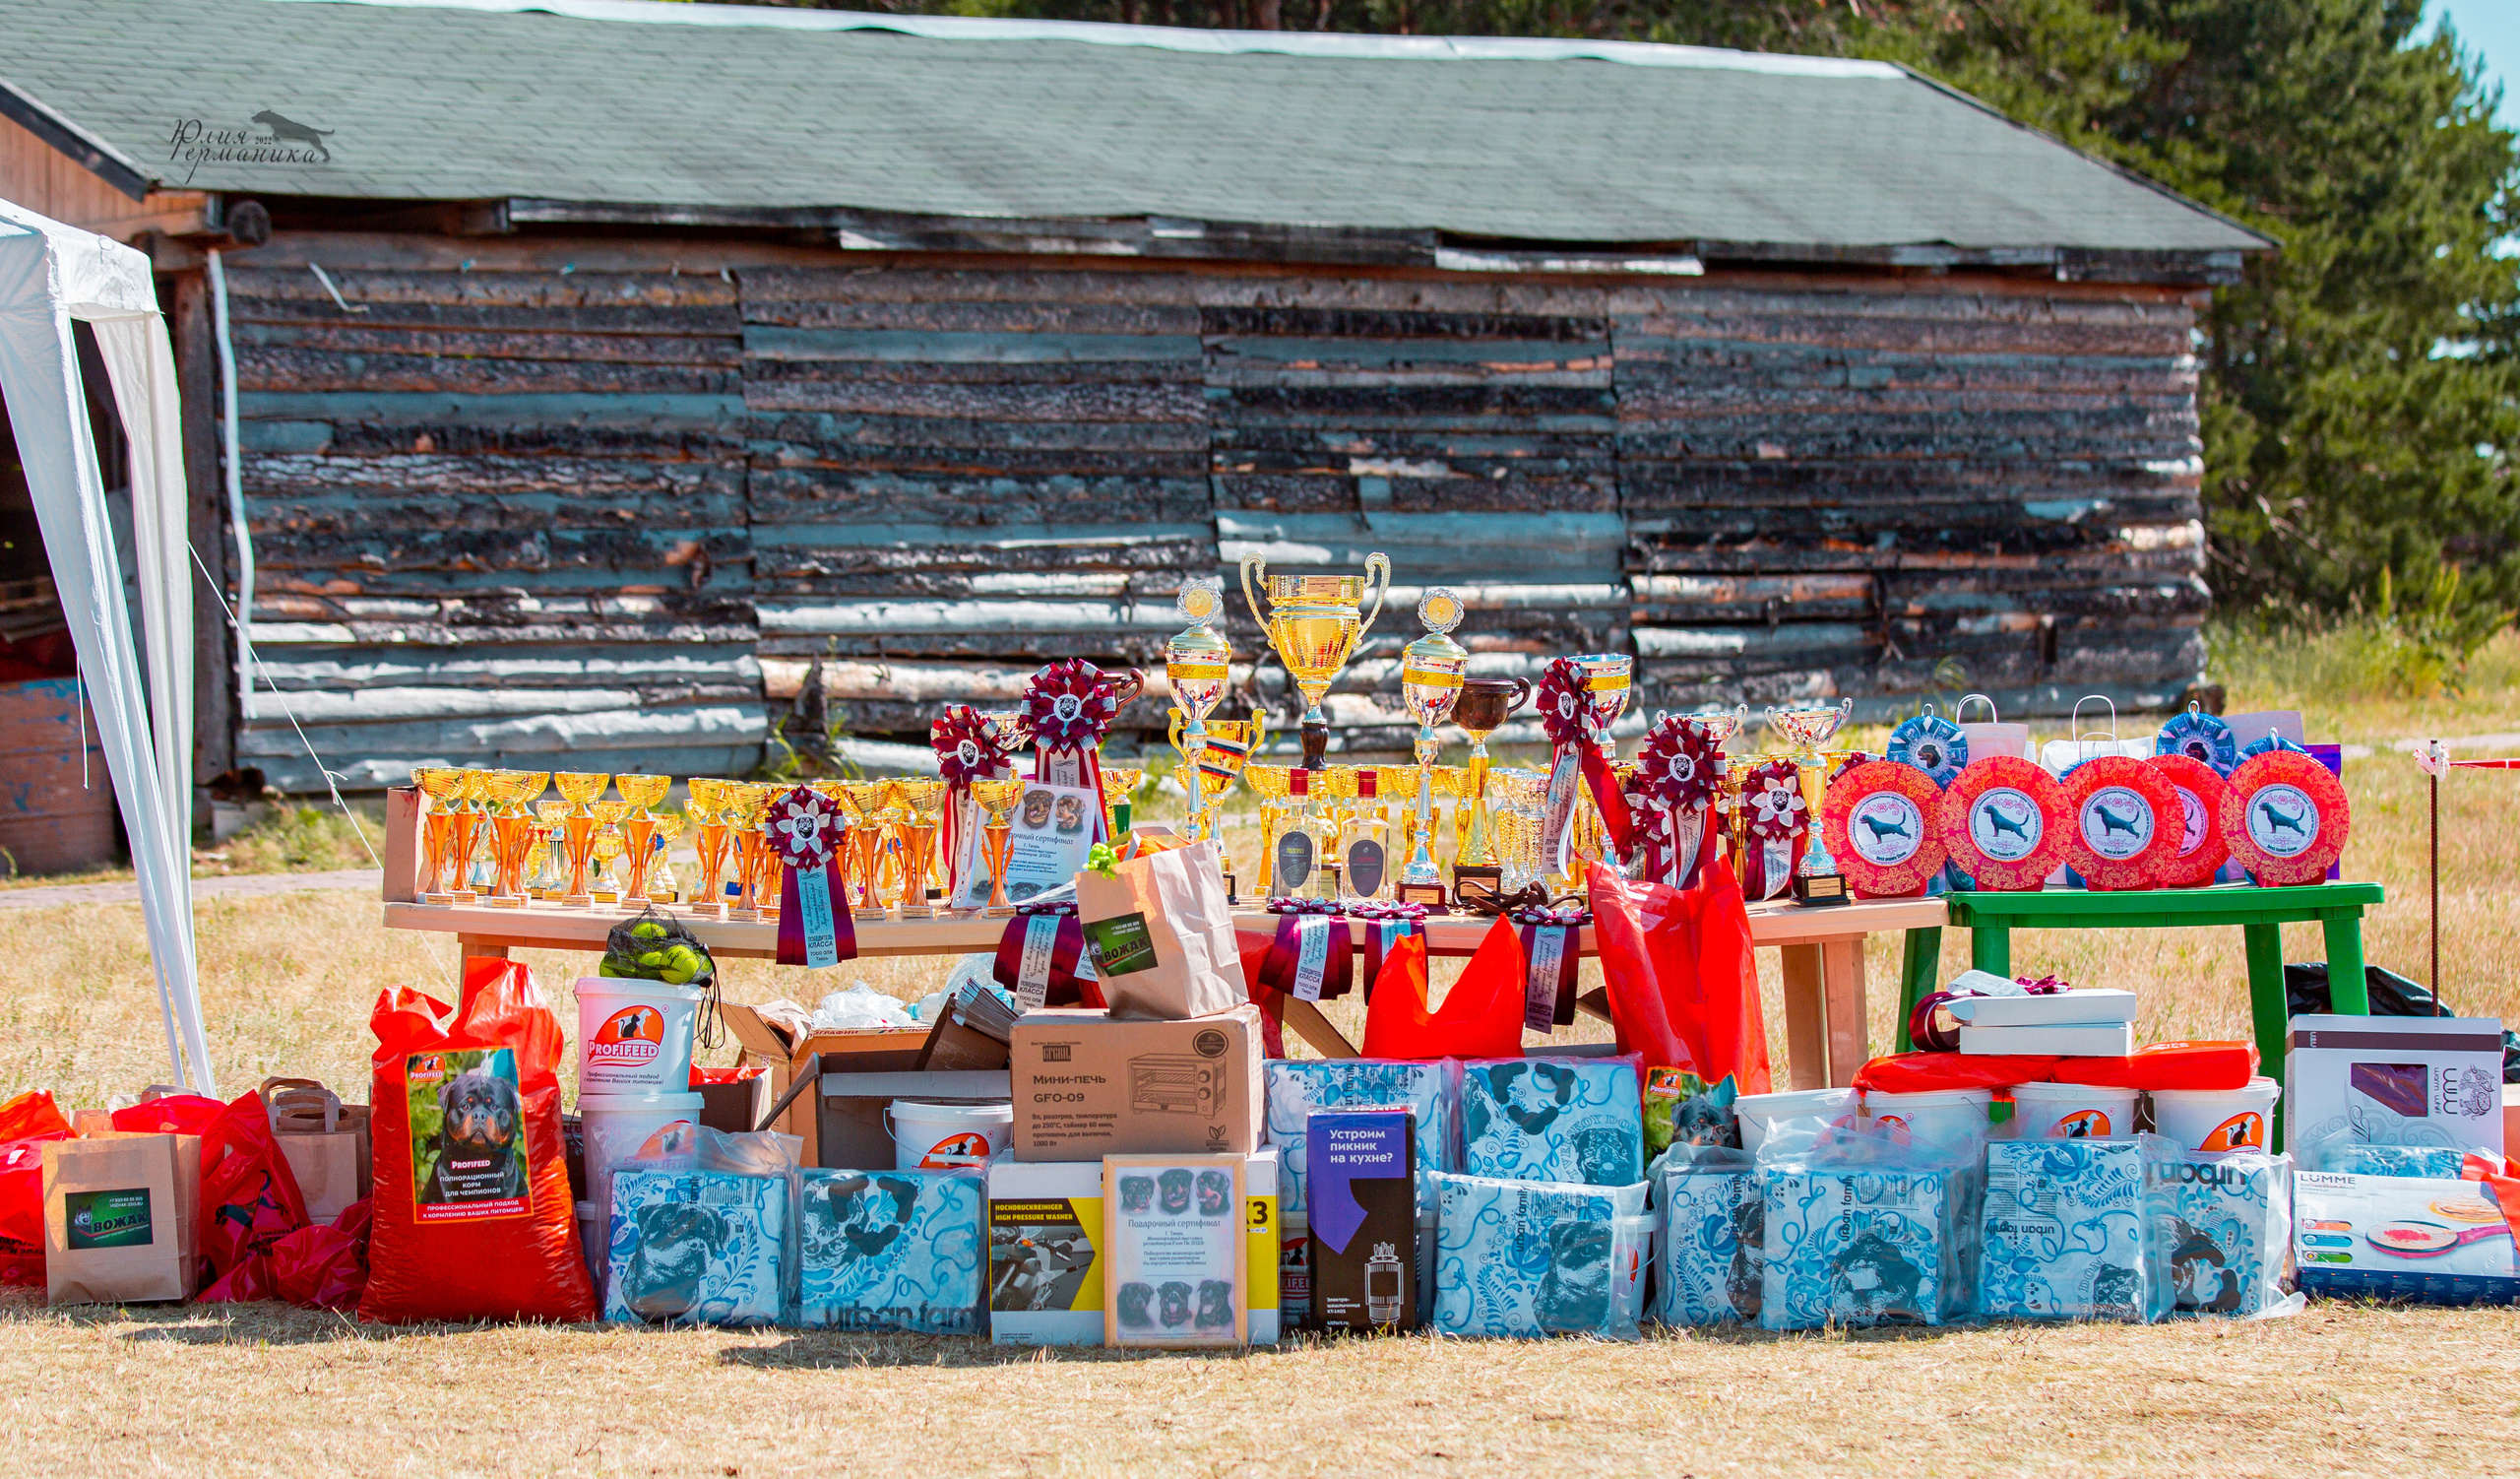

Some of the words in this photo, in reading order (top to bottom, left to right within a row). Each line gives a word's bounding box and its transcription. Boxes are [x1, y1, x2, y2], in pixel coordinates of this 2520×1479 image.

[808, 940, 834, 949] КЛАССА
[1103, 935, 1148, 962] ВОЖАК
[1298, 973, 1320, 984] КЛАССА
[1019, 986, 1043, 996] КЛАССА
[588, 1040, 659, 1058] PROFIFEED
[1034, 1093, 1085, 1103] GFO-09
[1330, 1129, 1386, 1141] Устроим
[1330, 1142, 1377, 1151] пикник
[451, 1160, 491, 1169] PROFIFEED
[1330, 1154, 1346, 1163] на
[1350, 1153, 1393, 1165] кухне?
[439, 1172, 505, 1183] ПОЛНОРАЦИОННЫЙ
[460, 1188, 501, 1196] ЧЕМПИОНОВ
[688, 1176, 703, 1206] family
[1843, 1175, 1856, 1206] family
[1516, 1186, 1531, 1215] family
[427, 1202, 493, 1211] ПРОФЕССИОНАЛЬНЫЙ
[94, 1212, 147, 1233] ВОЖАК
[1128, 1219, 1176, 1229] Подарочный
[1177, 1219, 1221, 1229] сертификат
[1839, 1209, 1851, 1242] urban
[1516, 1216, 1526, 1253] urban
[1984, 1224, 2018, 1235] family
[2021, 1225, 2054, 1236] urban
